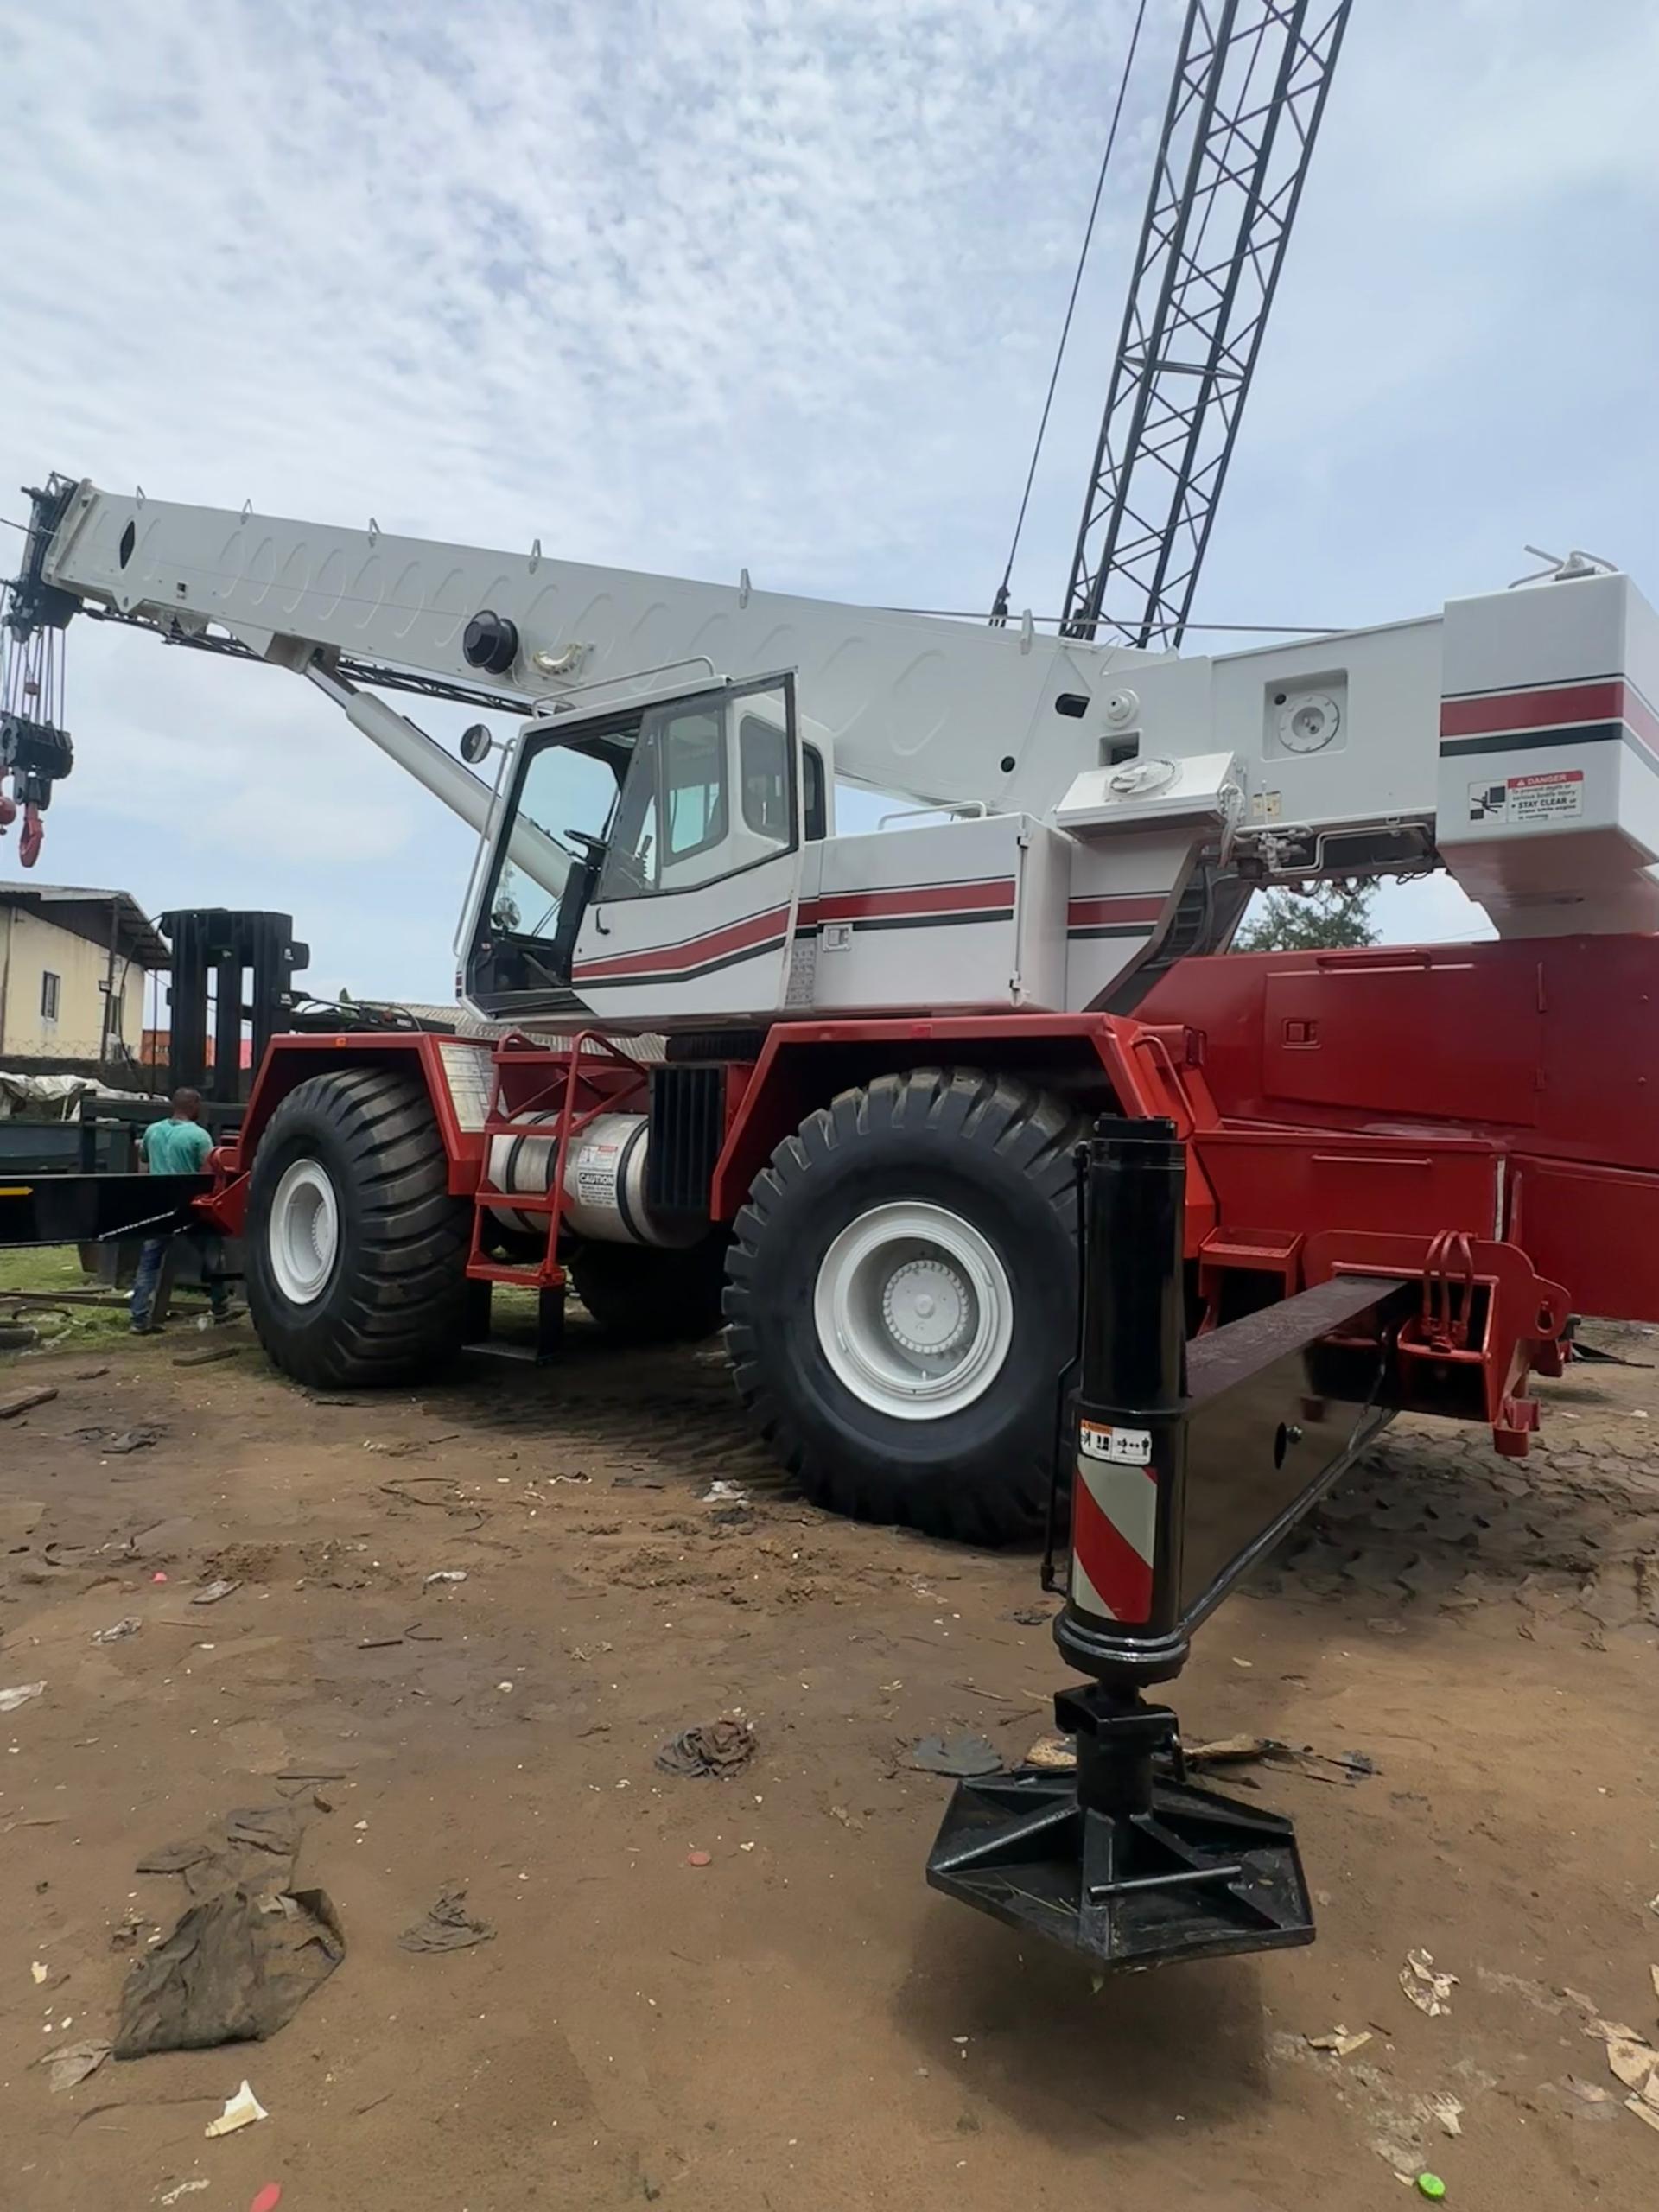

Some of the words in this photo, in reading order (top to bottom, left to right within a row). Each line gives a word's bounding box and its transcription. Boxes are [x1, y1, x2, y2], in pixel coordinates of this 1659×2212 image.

[1527, 774, 1567, 785] DANGER
[1518, 800, 1538, 809] STAY
[1541, 797, 1567, 806] CLEAR
[580, 1173, 613, 1185] CAUTION
